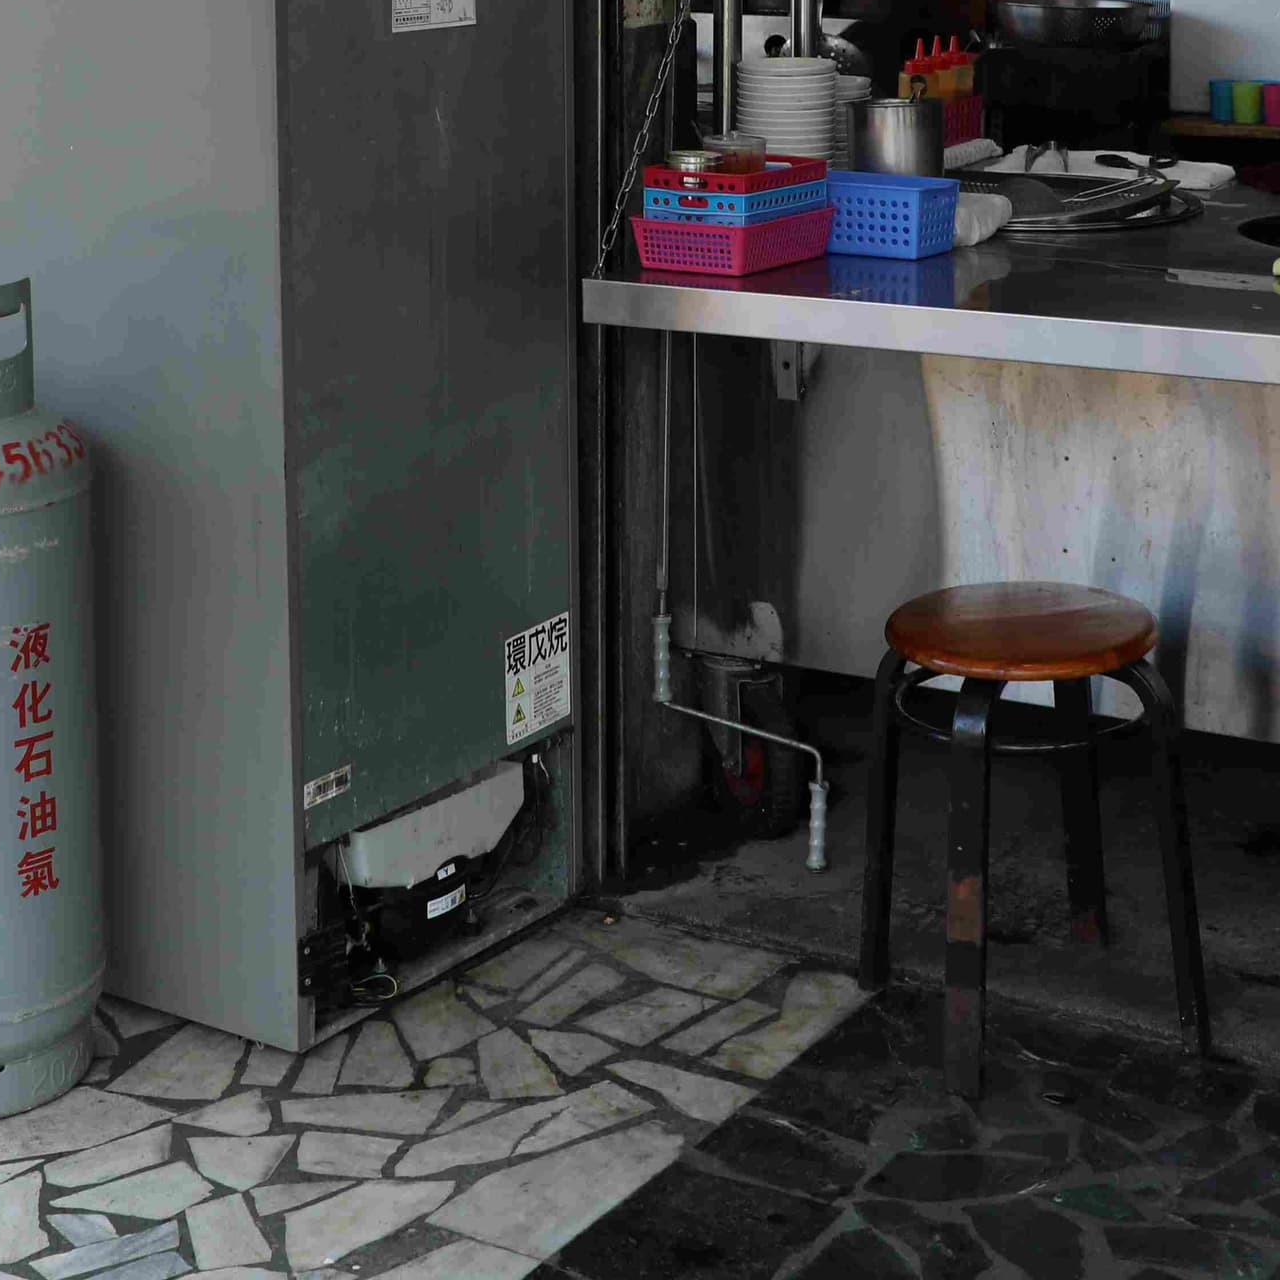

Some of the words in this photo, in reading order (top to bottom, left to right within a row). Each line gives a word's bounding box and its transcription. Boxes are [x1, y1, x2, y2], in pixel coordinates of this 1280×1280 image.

[505, 616, 568, 677] 環戊烷
[10, 621, 60, 899] 液化石油氣
